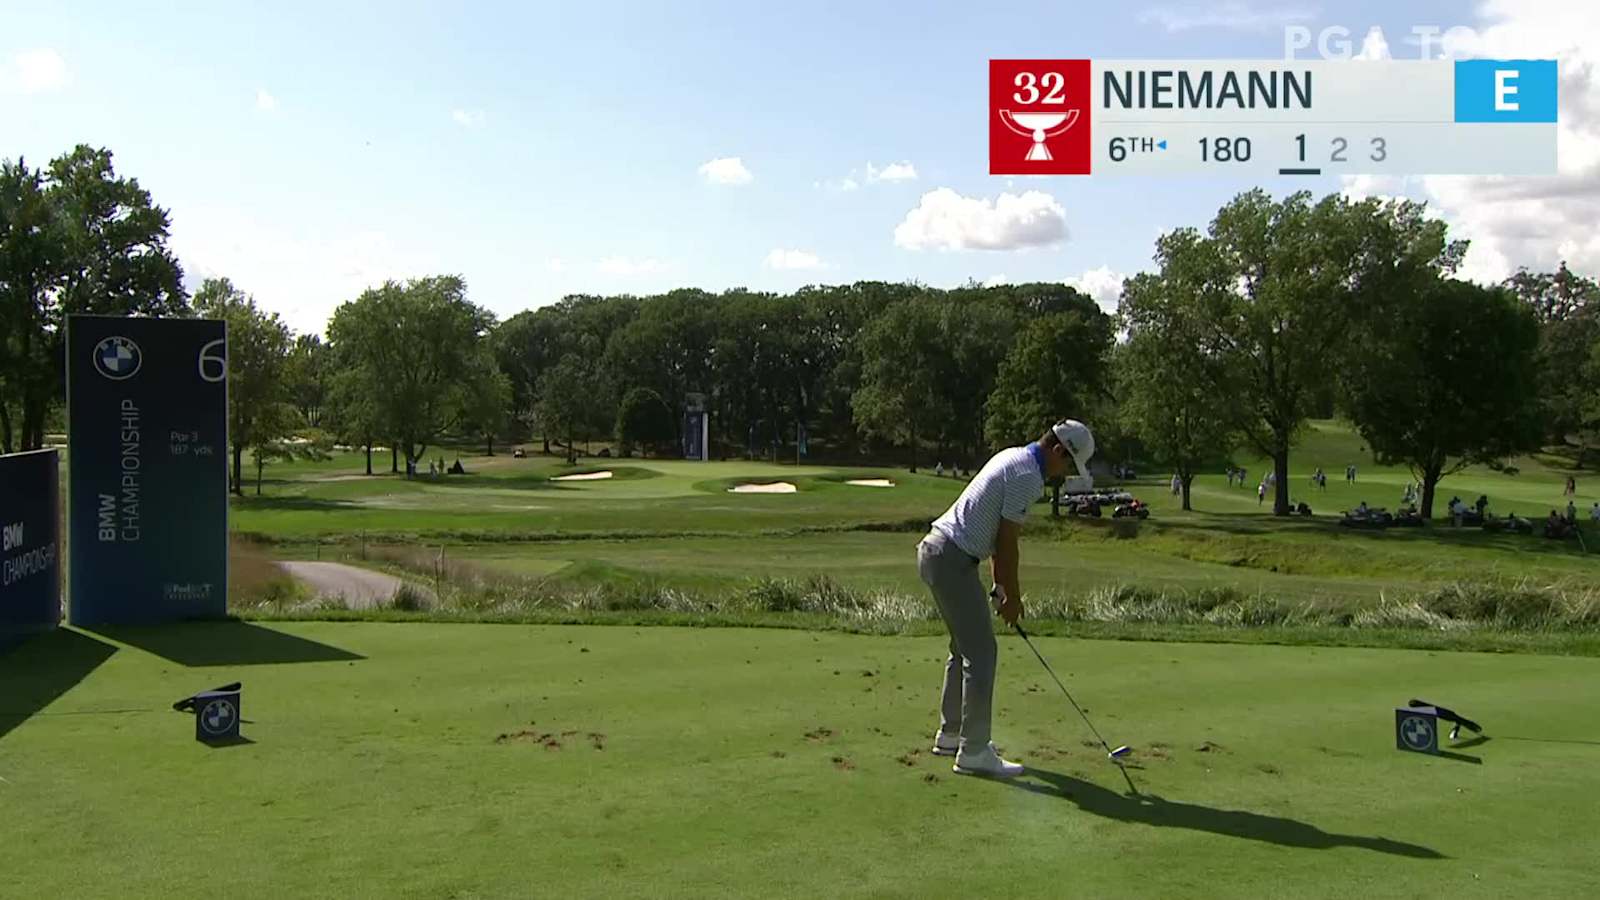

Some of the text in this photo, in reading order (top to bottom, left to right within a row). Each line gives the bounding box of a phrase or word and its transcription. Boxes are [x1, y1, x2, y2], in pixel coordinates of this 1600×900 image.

[198, 339, 225, 382] 6
[121, 399, 140, 541] CHAMPIONSHIP
[3, 521, 23, 551] BMW
[99, 493, 116, 541] BMW
